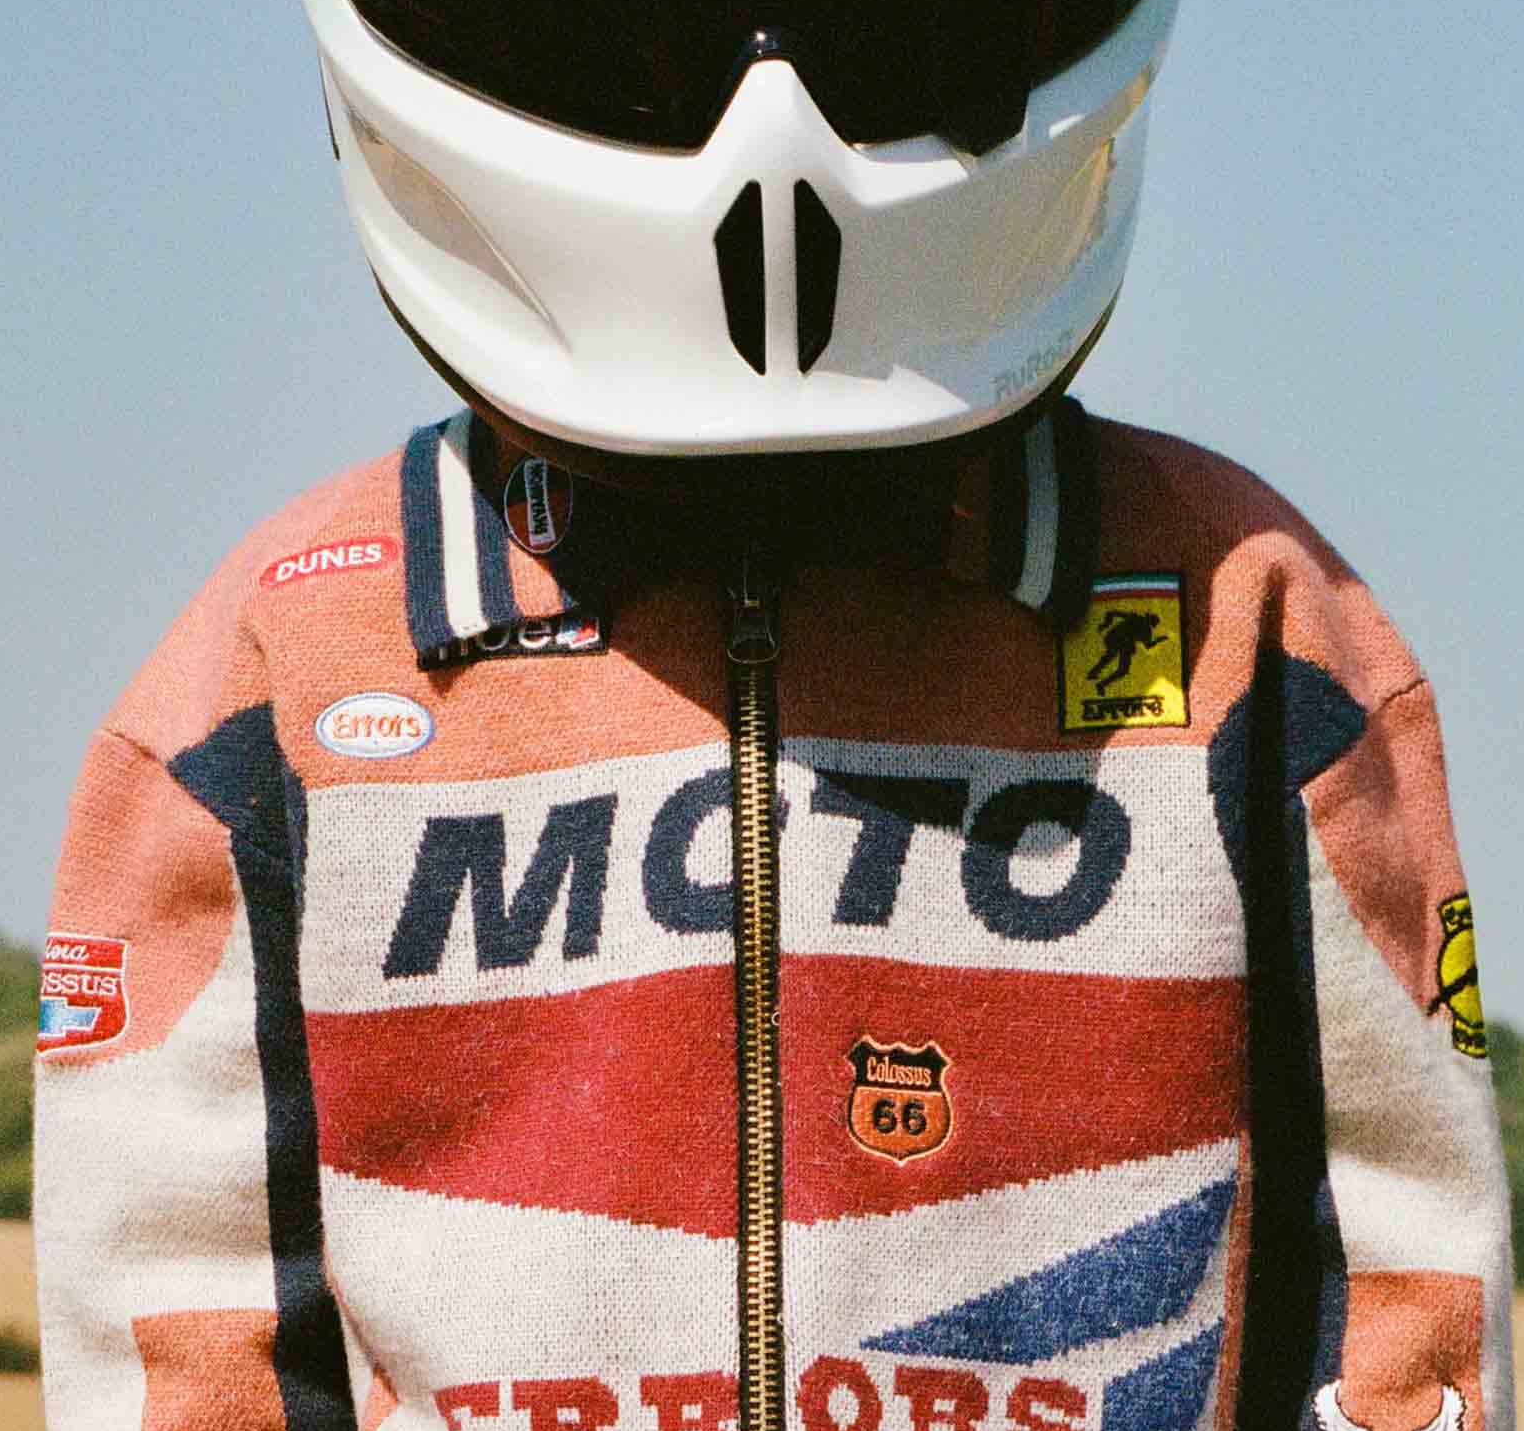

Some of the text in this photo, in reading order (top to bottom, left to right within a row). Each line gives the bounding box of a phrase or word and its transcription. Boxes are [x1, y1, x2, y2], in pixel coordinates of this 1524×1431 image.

[276, 543, 382, 582] DUNES
[332, 712, 422, 738] Errors
[384, 767, 1133, 979] MOTO
[866, 1055, 932, 1087] Colossus
[872, 1097, 928, 1136] 66
